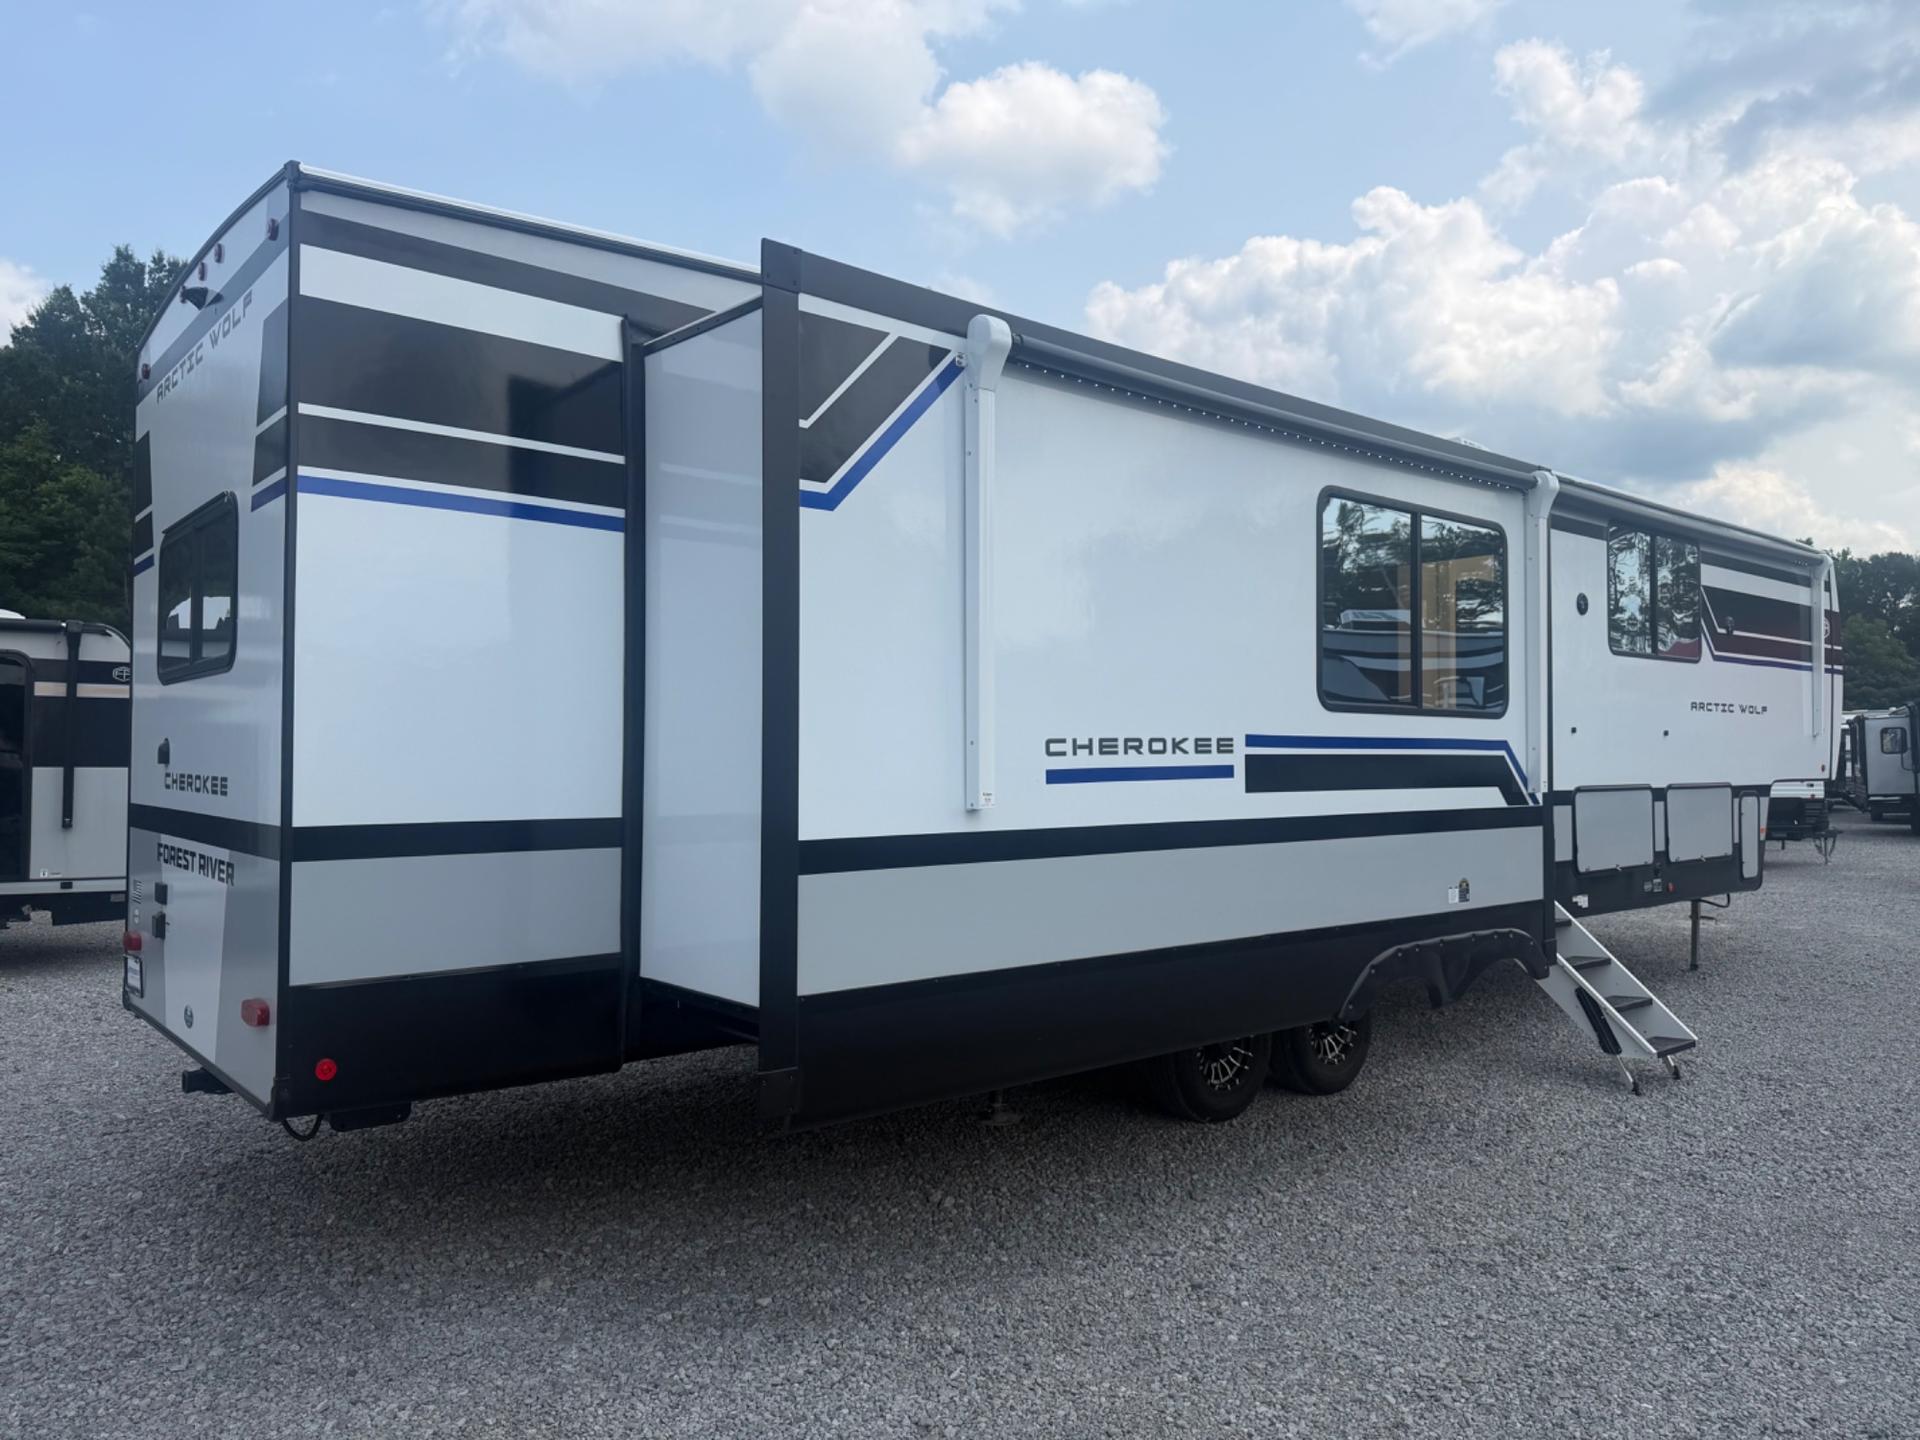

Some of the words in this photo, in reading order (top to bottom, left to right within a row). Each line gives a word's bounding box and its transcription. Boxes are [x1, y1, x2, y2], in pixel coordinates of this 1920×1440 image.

[156, 342, 206, 404] ARCTIC
[209, 289, 254, 350] WOLF
[1690, 701, 1735, 713] ARCTIC
[1739, 704, 1768, 715] WOLF
[1045, 736, 1235, 757] CHEROKEE
[164, 772, 229, 796] CHEROKEE
[156, 842, 196, 872] FOREST
[198, 855, 235, 886] RIVER
